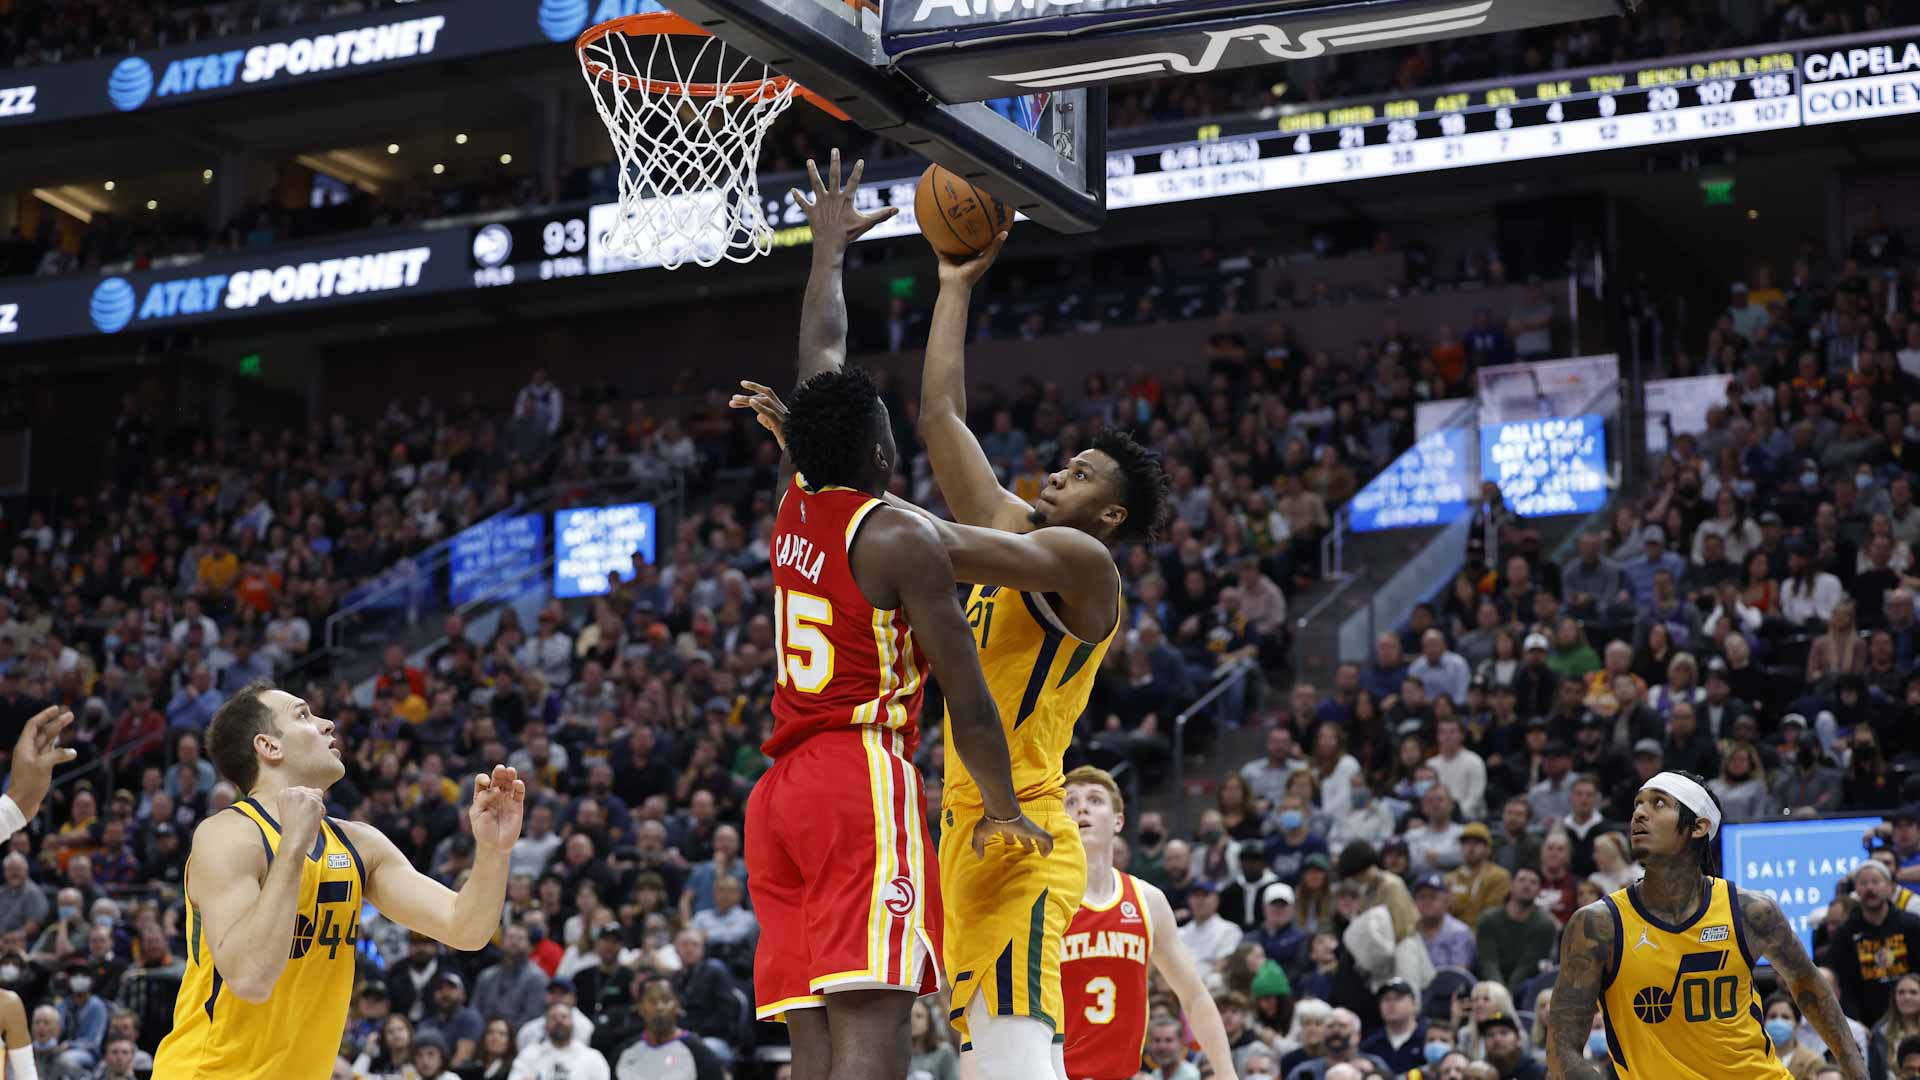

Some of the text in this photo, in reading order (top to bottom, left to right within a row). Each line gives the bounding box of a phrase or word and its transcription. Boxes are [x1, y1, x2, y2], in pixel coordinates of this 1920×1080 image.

[157, 15, 445, 97] AT&T SPORTSNET
[1804, 43, 1920, 82] CAPELA
[1546, 101, 1564, 123] 4
[1648, 86, 1680, 111] 20
[1696, 79, 1737, 106] 107
[1754, 103, 1789, 123] 107
[1809, 83, 1920, 114] CONLEY
[543, 218, 586, 256] 93
[138, 246, 430, 320] AT&T SPORTSNET
[775, 533, 826, 584] CAPELA
[774, 585, 835, 694] 15
[1746, 860, 1796, 879] SALT
[318, 910, 358, 960] 44
[1060, 931, 1145, 964] ATLANTA
[1084, 976, 1116, 1024] 3
[1683, 975, 1738, 1023] 00
